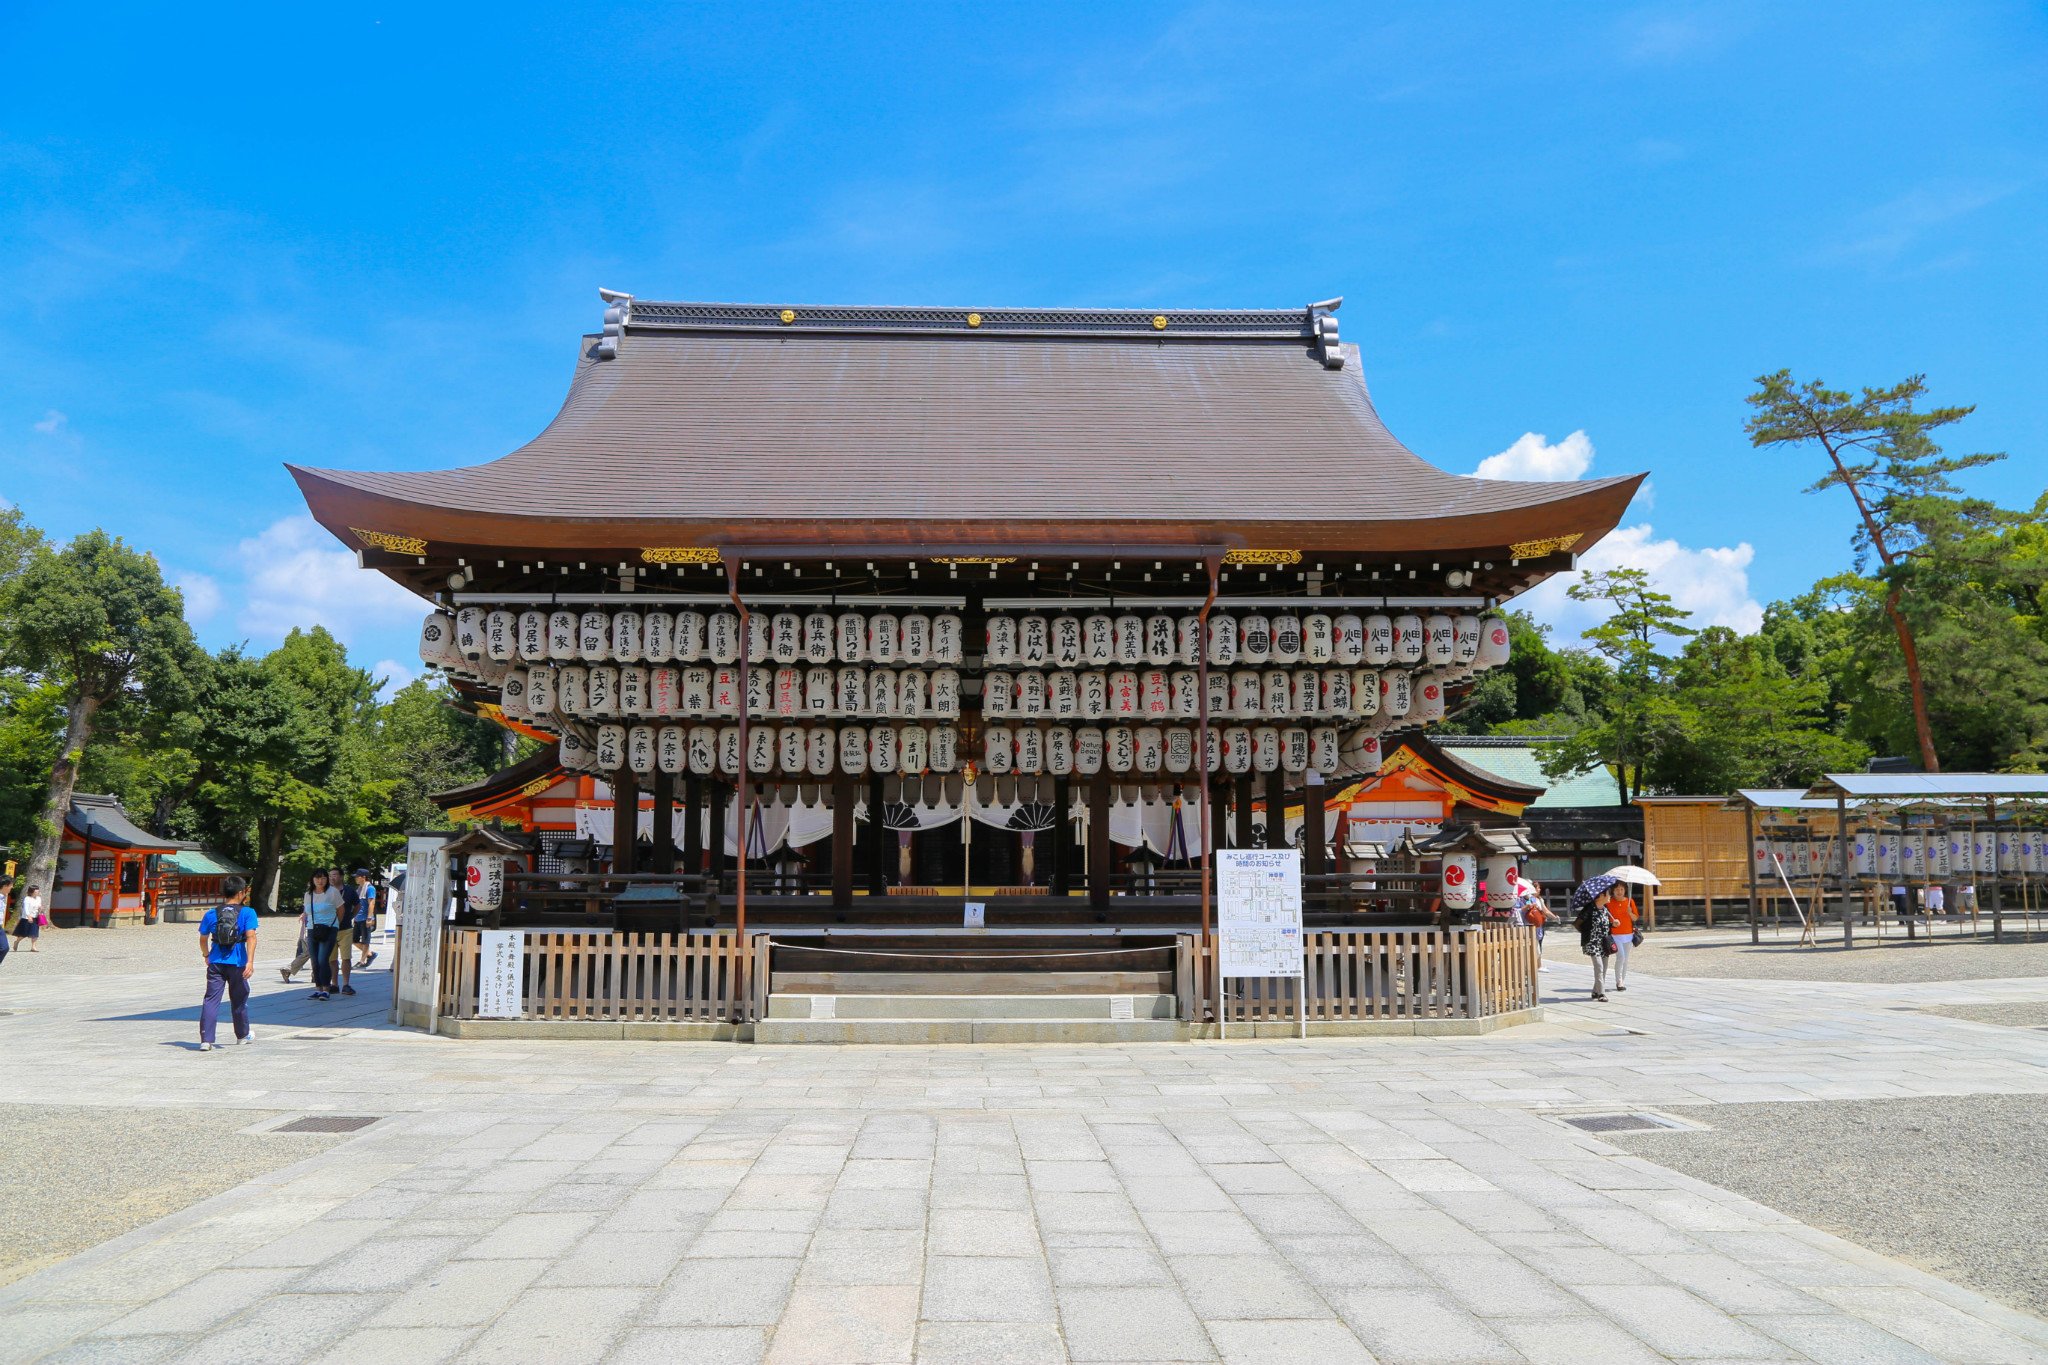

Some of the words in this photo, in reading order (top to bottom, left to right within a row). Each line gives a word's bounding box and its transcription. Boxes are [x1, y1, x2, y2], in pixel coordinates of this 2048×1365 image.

[490, 614, 504, 654] 鳥居本
[525, 614, 539, 654] 鳥居本
[584, 616, 599, 651] 辻留
[778, 617, 793, 657] 権兵衛
[811, 617, 826, 657] 権兵衛
[1027, 620, 1044, 662] 京ばん
[1061, 620, 1076, 662] 京ばん
[1092, 619, 1106, 658] 京ばん
[1344, 629, 1361, 656] 畑中
[1372, 628, 1389, 654] 畑中
[1402, 630, 1420, 656] 畑中
[1432, 629, 1451, 654] 畑中
[1460, 632, 1478, 658] 畑中
[592, 671, 606, 706] キメラ
[625, 672, 638, 708] 池田家
[717, 672, 732, 706] 豆花
[748, 670, 761, 708] 美の八重
[812, 672, 824, 709] 川口
[992, 675, 1006, 712] 矢野一郎
[1028, 675, 1040, 714] 矢野一郎
[1059, 676, 1072, 714] 矢野一郎
[1088, 676, 1102, 714] みの家
[1118, 674, 1132, 712] 小富美
[1151, 674, 1165, 712] 豆千鶴
[1180, 674, 1193, 712] やなぎ
[634, 729, 648, 768] 元奈古
[664, 729, 676, 768] 元奈古
[878, 730, 890, 768] 花さくら
[992, 732, 1006, 767] 小愛
[1117, 729, 1128, 766] おくむら
